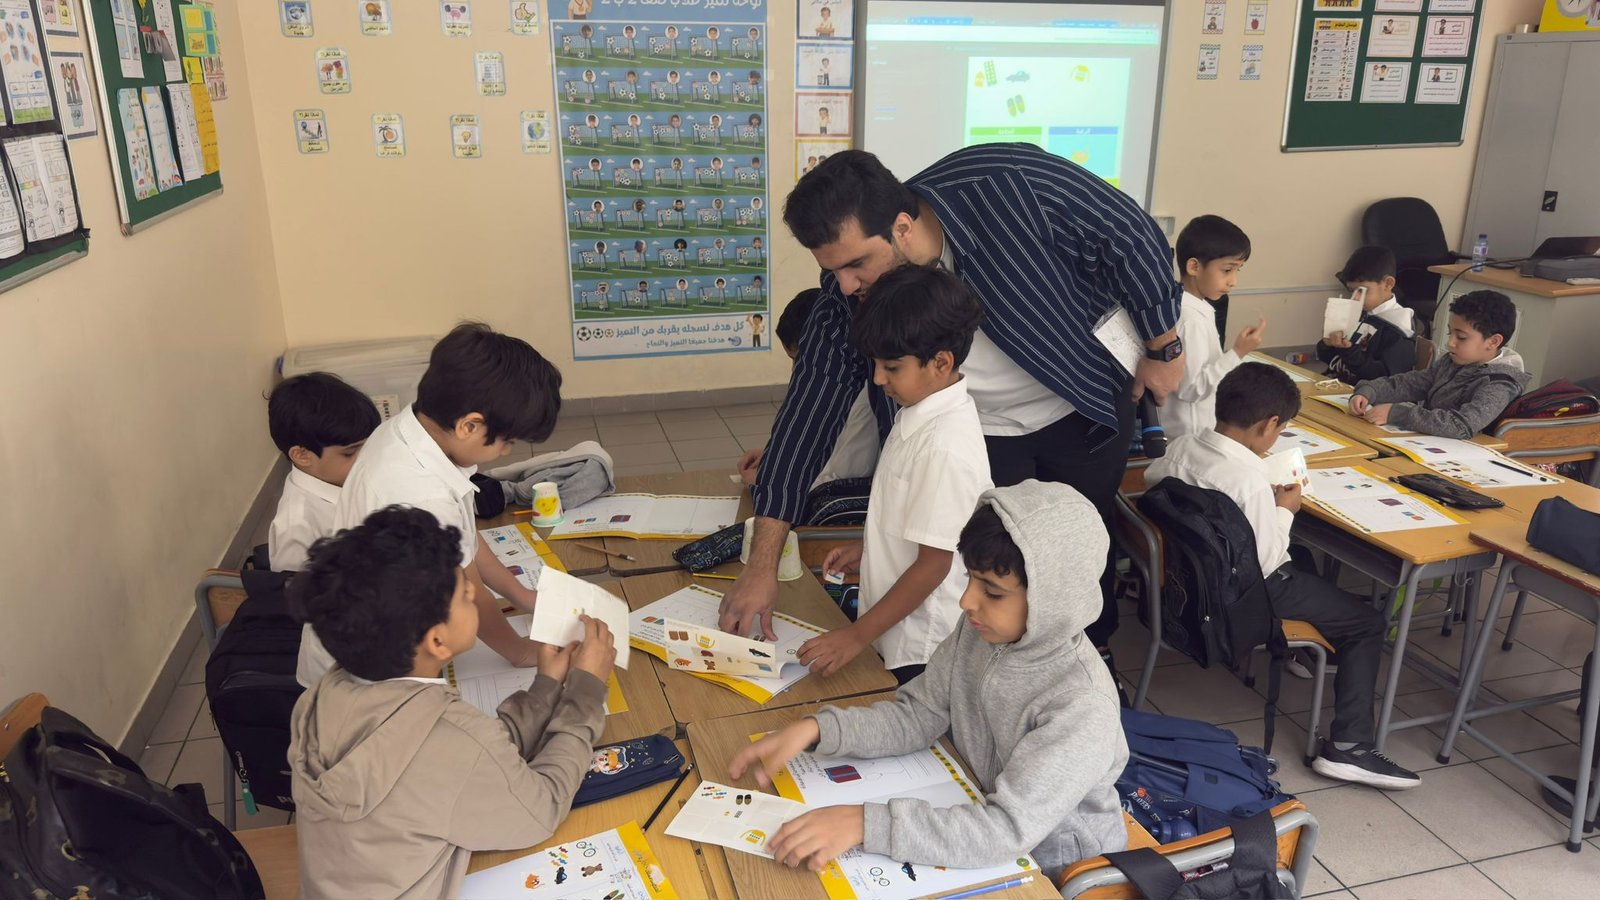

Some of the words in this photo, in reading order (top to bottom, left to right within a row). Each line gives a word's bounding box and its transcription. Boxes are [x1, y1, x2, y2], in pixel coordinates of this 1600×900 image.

[712, 323, 731, 332] هدف
[733, 321, 745, 332] كل
[616, 326, 640, 338] التميز
[641, 327, 655, 337] من
